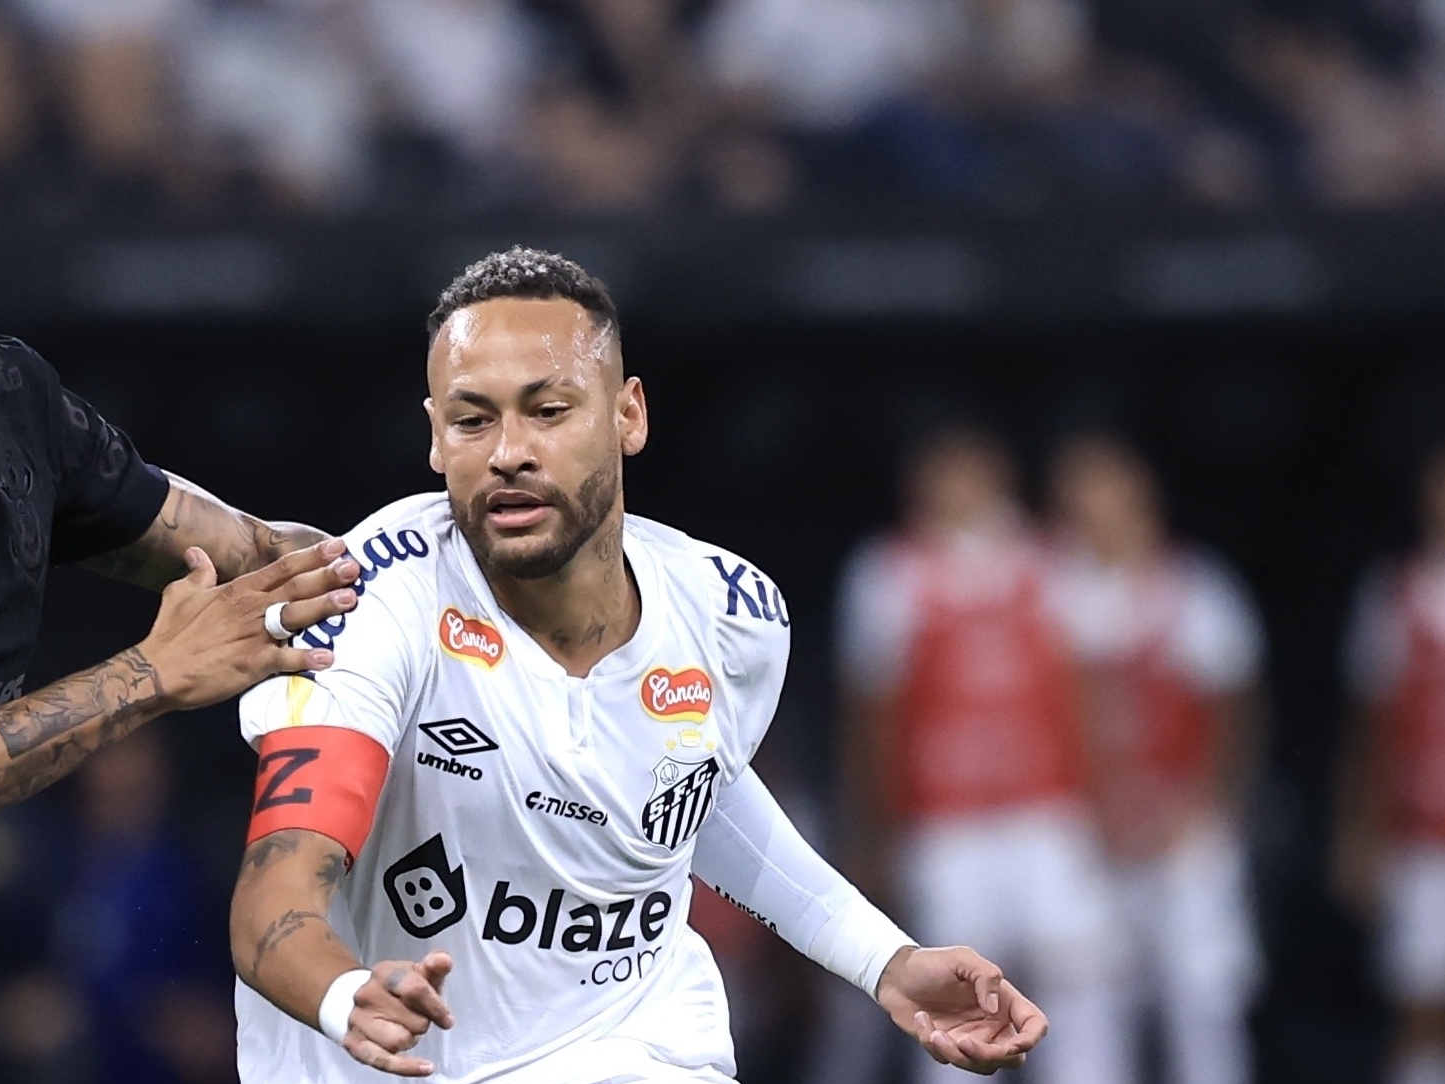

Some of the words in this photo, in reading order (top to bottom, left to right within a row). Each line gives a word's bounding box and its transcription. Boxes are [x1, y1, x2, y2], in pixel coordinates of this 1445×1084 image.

[649, 674, 711, 711] Canção
[417, 752, 483, 780] umbro
[482, 881, 672, 952] blaze
